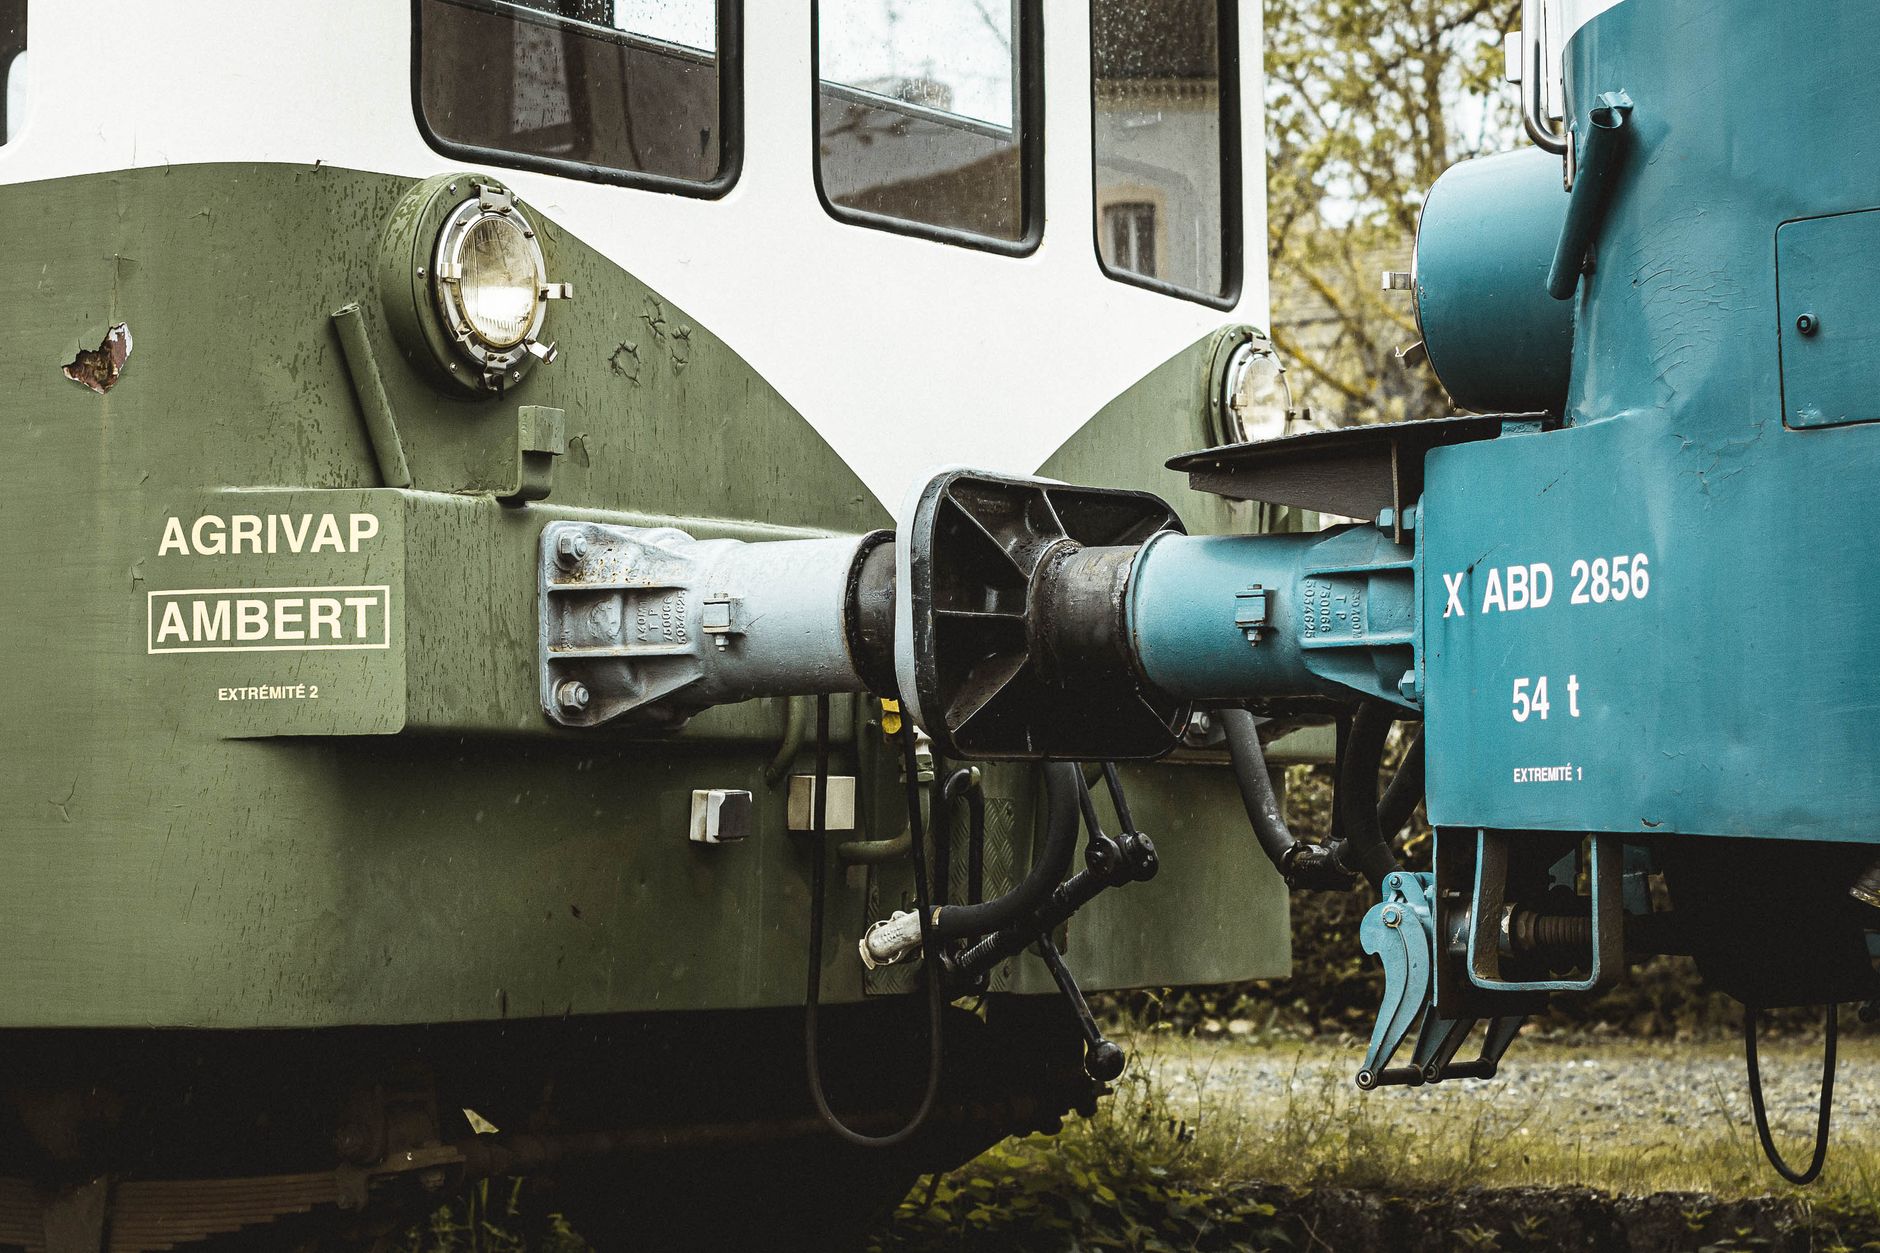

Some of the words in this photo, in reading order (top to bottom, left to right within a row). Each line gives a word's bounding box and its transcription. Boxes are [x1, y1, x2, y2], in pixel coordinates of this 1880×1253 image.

[157, 513, 380, 556] AGRIVAP
[1303, 579, 1316, 638] 5034625
[1320, 583, 1332, 633] 750066
[1442, 572, 1465, 618] X
[1481, 563, 1554, 614] ABD
[1570, 552, 1650, 605] 2856
[156, 597, 378, 643] AMBERT
[218, 683, 306, 701] EXTRÉMITÉ
[309, 685, 319, 699] 2
[1511, 676, 1550, 723] 54
[1566, 674, 1580, 718] t
[1513, 763, 1573, 783] EXTREMITÉ
[1576, 766, 1583, 781] 1
